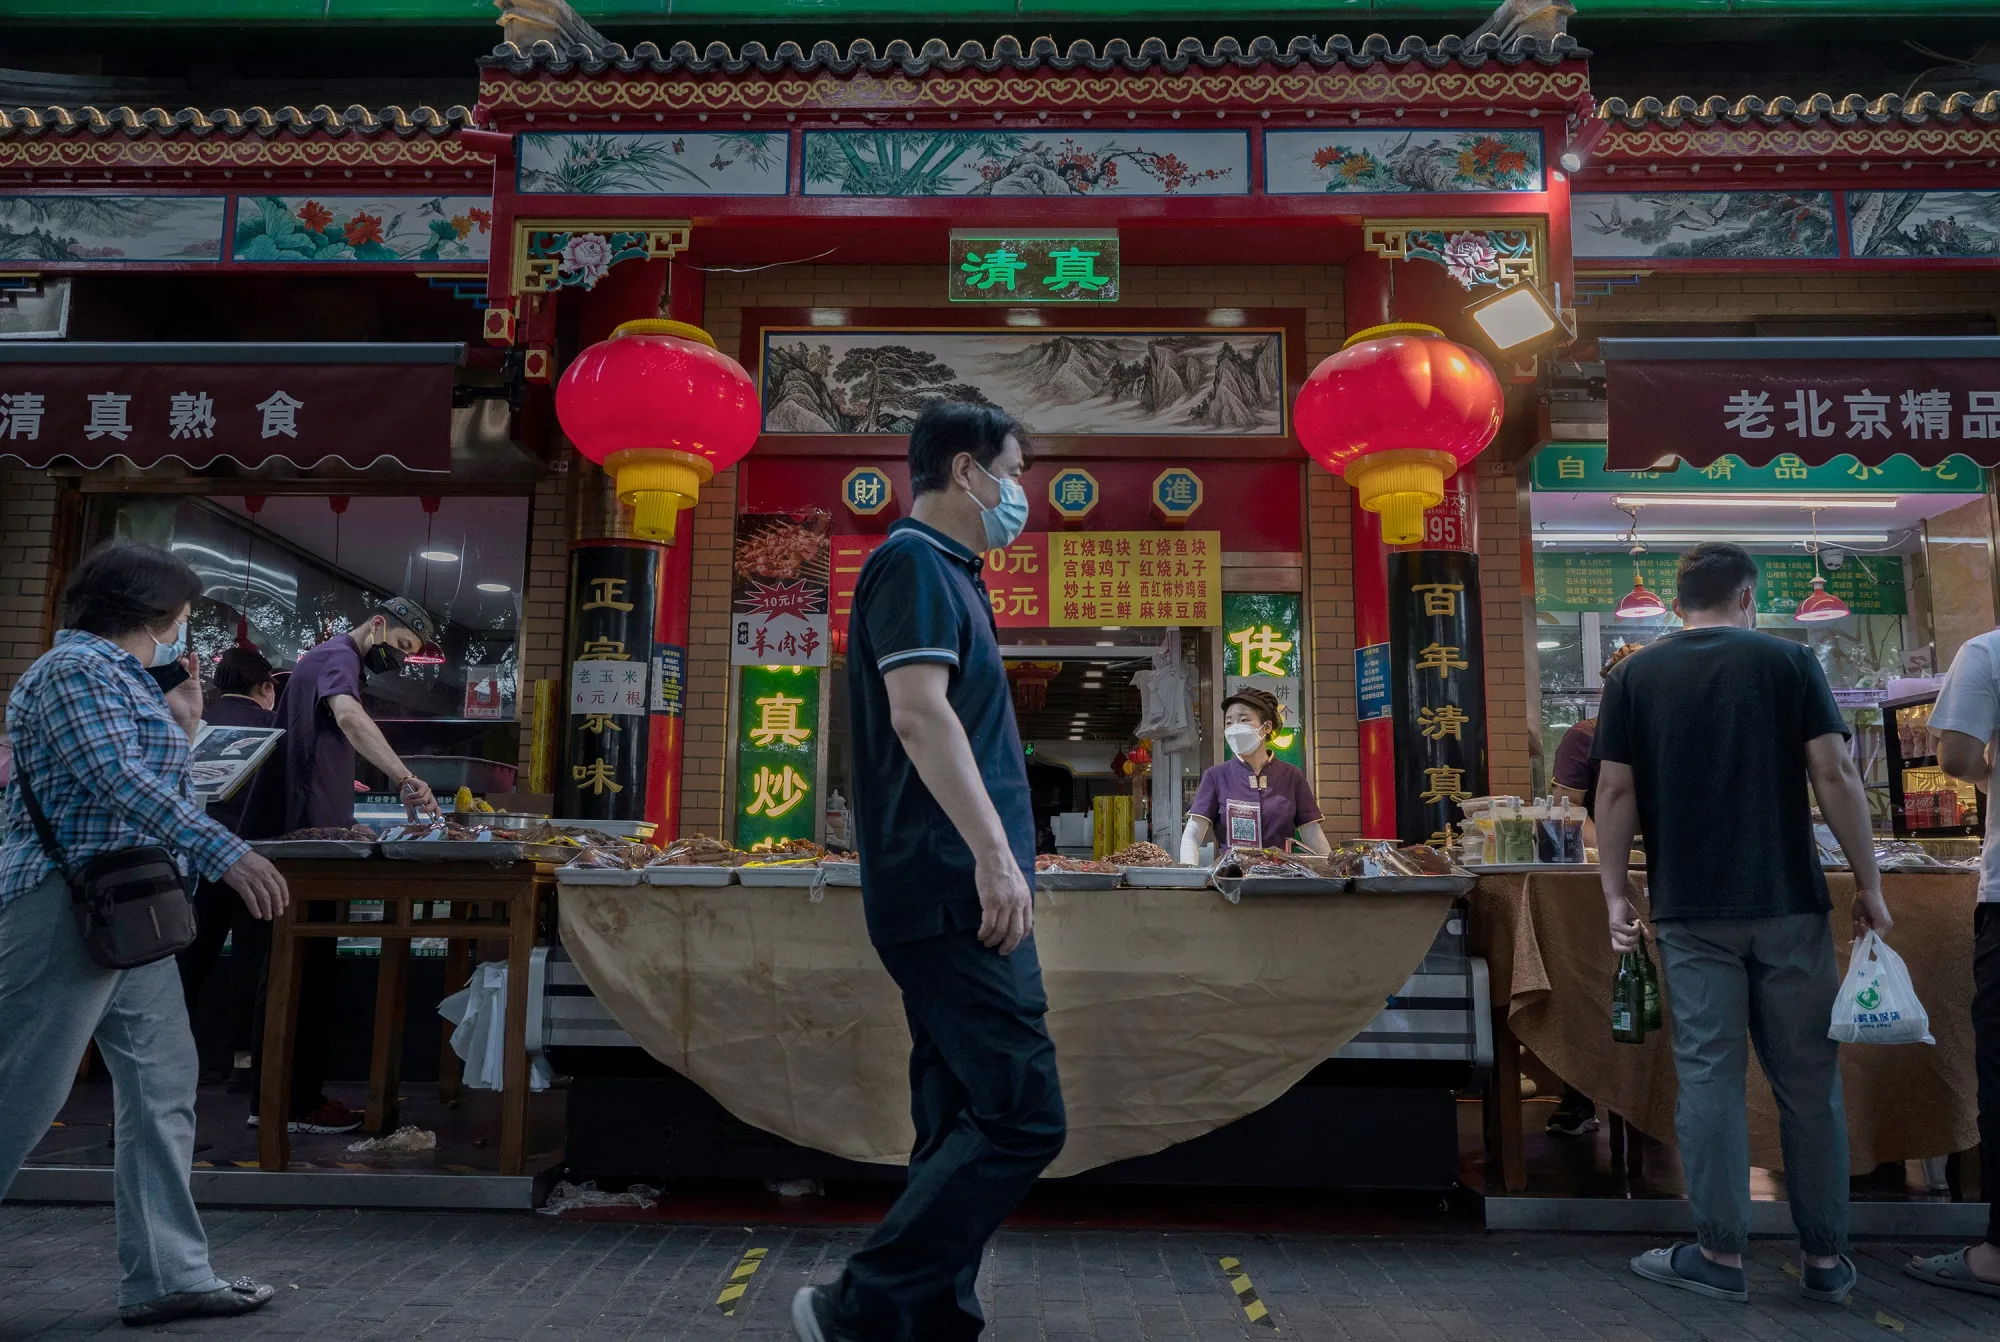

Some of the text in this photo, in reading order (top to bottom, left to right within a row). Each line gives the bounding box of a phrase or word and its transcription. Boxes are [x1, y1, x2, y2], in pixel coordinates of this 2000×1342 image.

[960, 246, 1110, 291] 清真
[0, 390, 304, 441] 清真熟食
[1723, 388, 2000, 440] 老北京精品
[1557, 456, 1958, 481] 自精品小吃
[853, 476, 1193, 505] 財 廣 進
[980, 545, 1039, 574] 0元
[1063, 538, 1207, 556] 红烧鸡块 红烧鱼块
[1063, 559, 1207, 577] 宫爆鸡丁 红烧丸子
[1063, 580, 1207, 598] 炒土豆丝 西红柿炒鸡蛋
[1063, 601, 1207, 619] 烧地三鲜 麻辣豆腐
[748, 627, 820, 660] 羊肉串
[578, 669, 638, 684] 老玉米
[577, 691, 643, 706] 6元/根
[746, 665, 811, 852] 真炒
